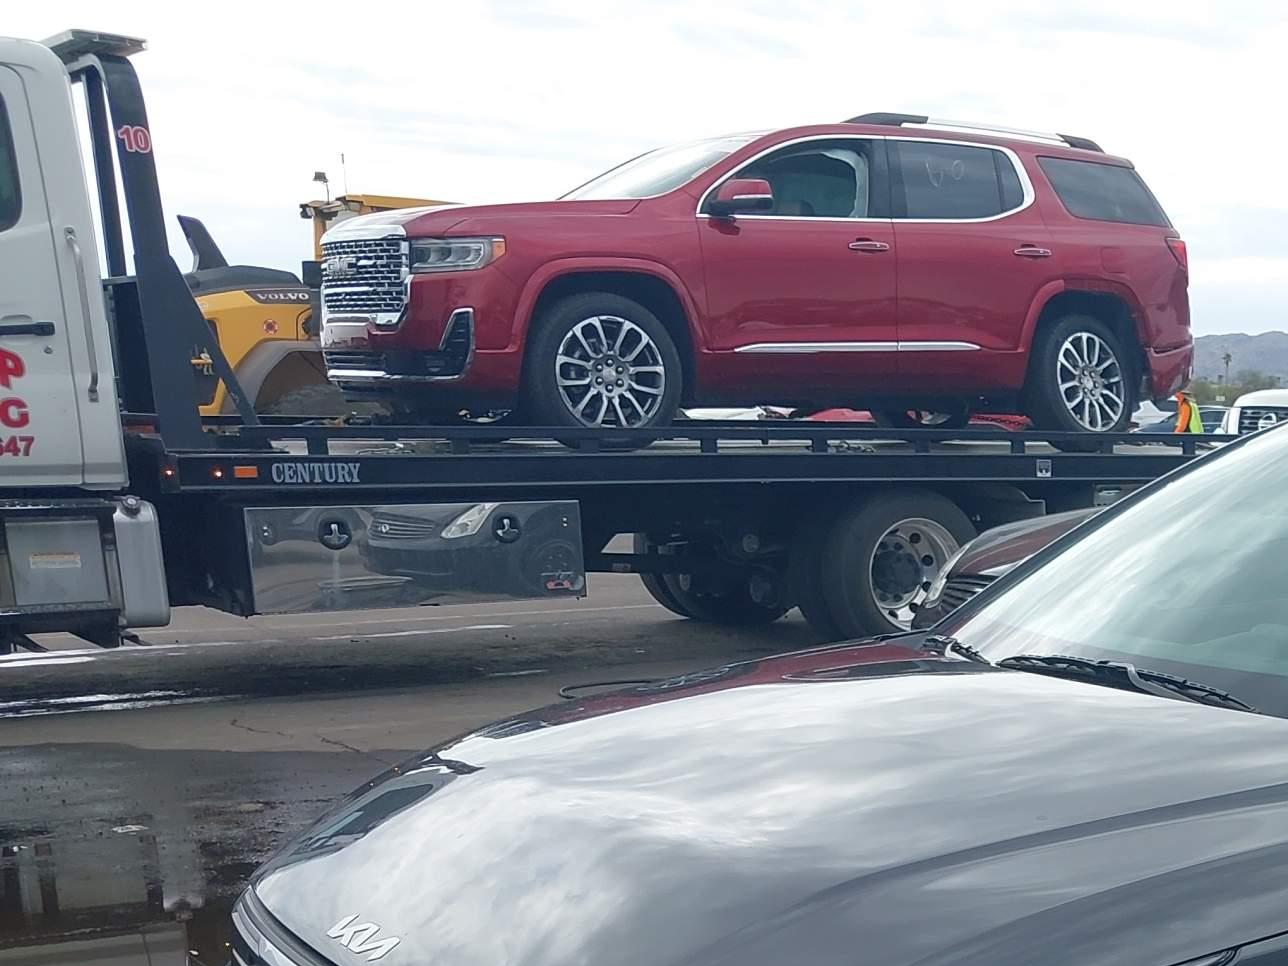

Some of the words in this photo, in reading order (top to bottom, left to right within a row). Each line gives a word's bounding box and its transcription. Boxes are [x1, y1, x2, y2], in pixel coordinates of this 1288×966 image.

[117, 125, 151, 153] 10
[257, 292, 310, 301] VOLVO
[271, 463, 361, 484] CENTURY
[326, 912, 401, 962] KIA
